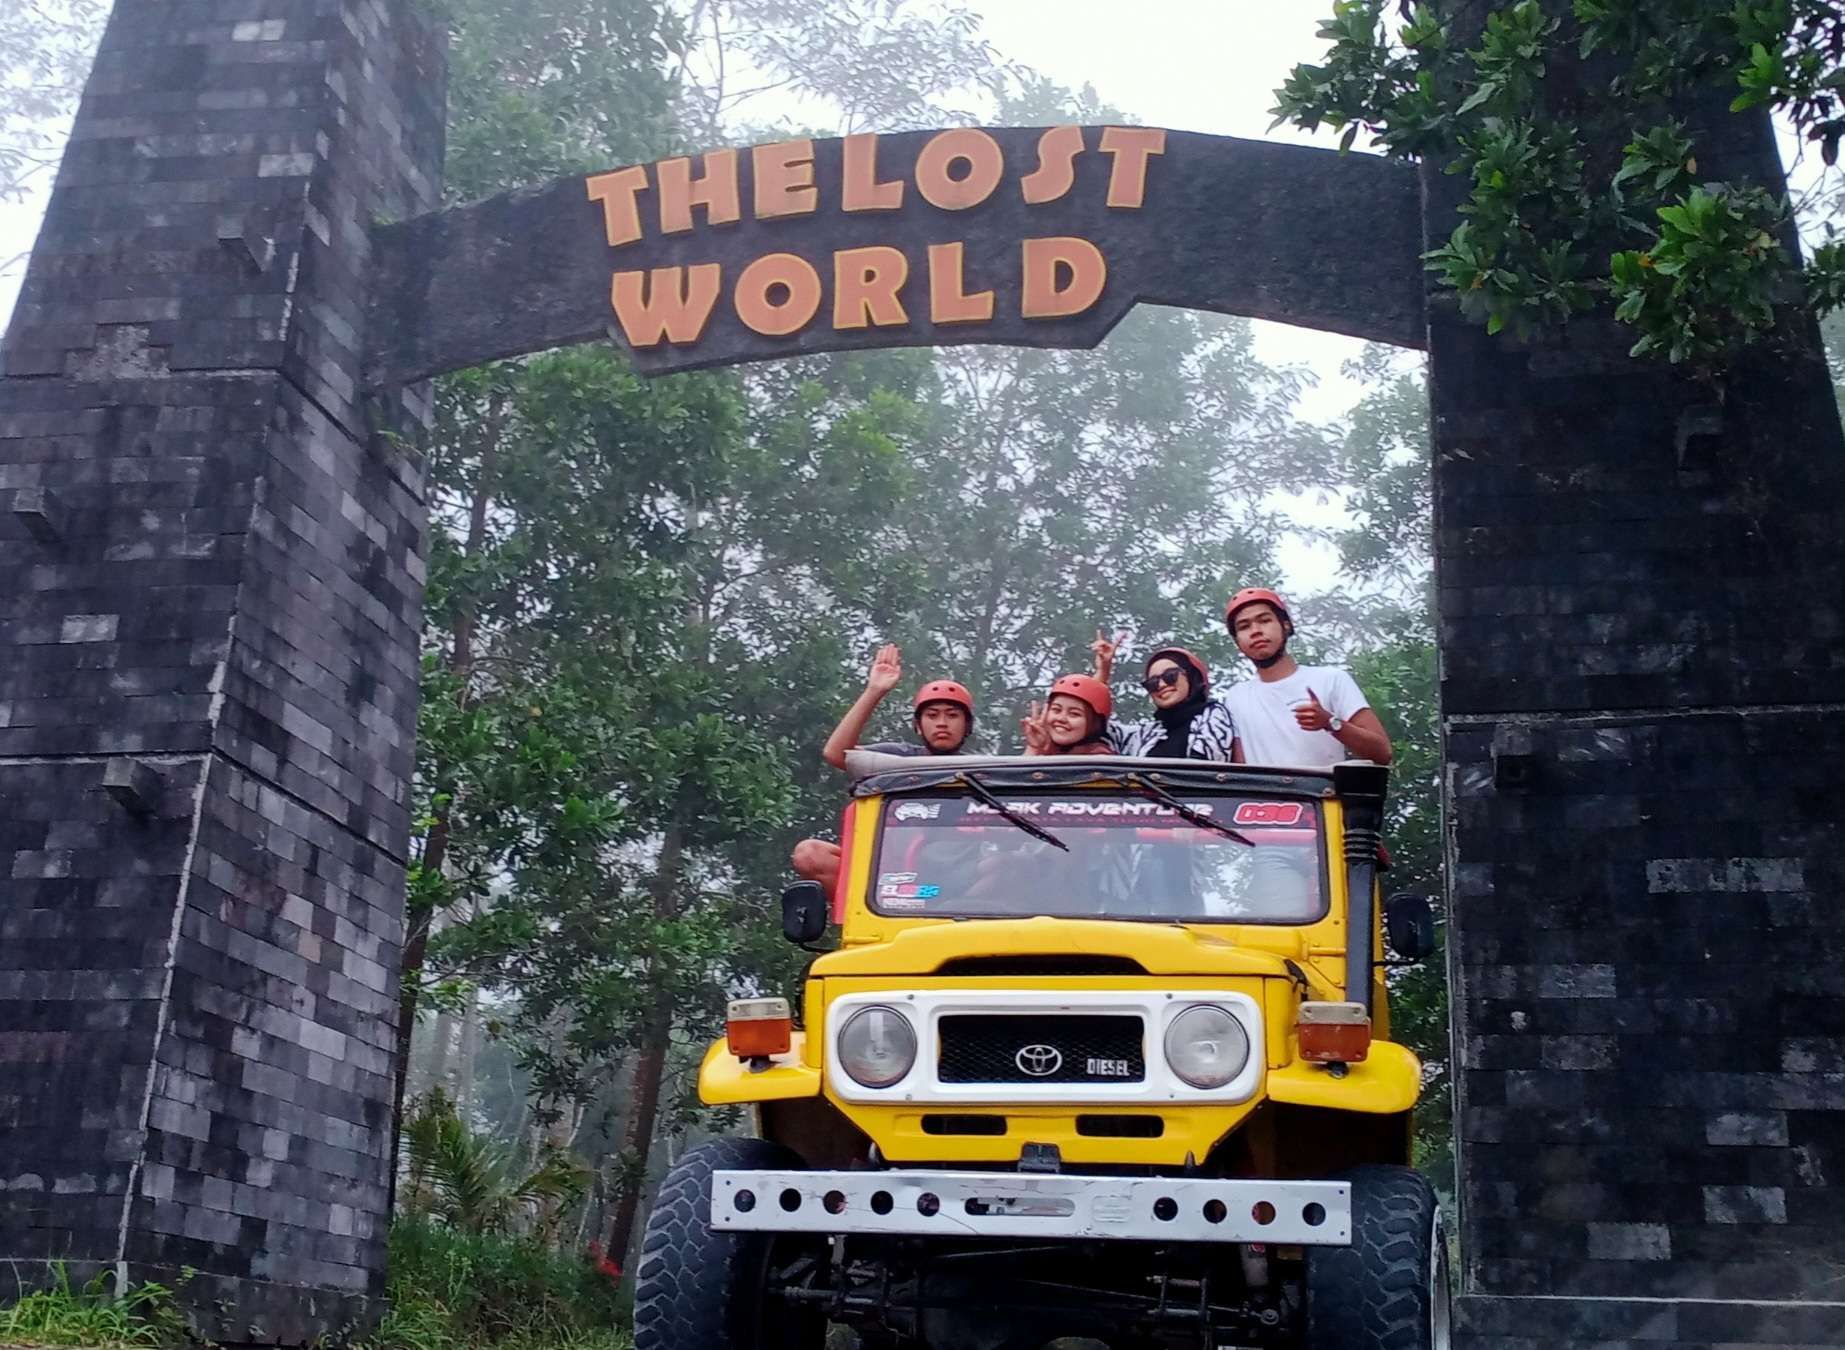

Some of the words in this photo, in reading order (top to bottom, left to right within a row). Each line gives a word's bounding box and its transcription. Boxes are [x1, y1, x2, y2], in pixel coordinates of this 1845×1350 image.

[586, 138, 818, 247] THE
[841, 125, 1167, 212] LOST
[611, 236, 1107, 347] WORLD
[1086, 1058, 1130, 1076] DIESEL
